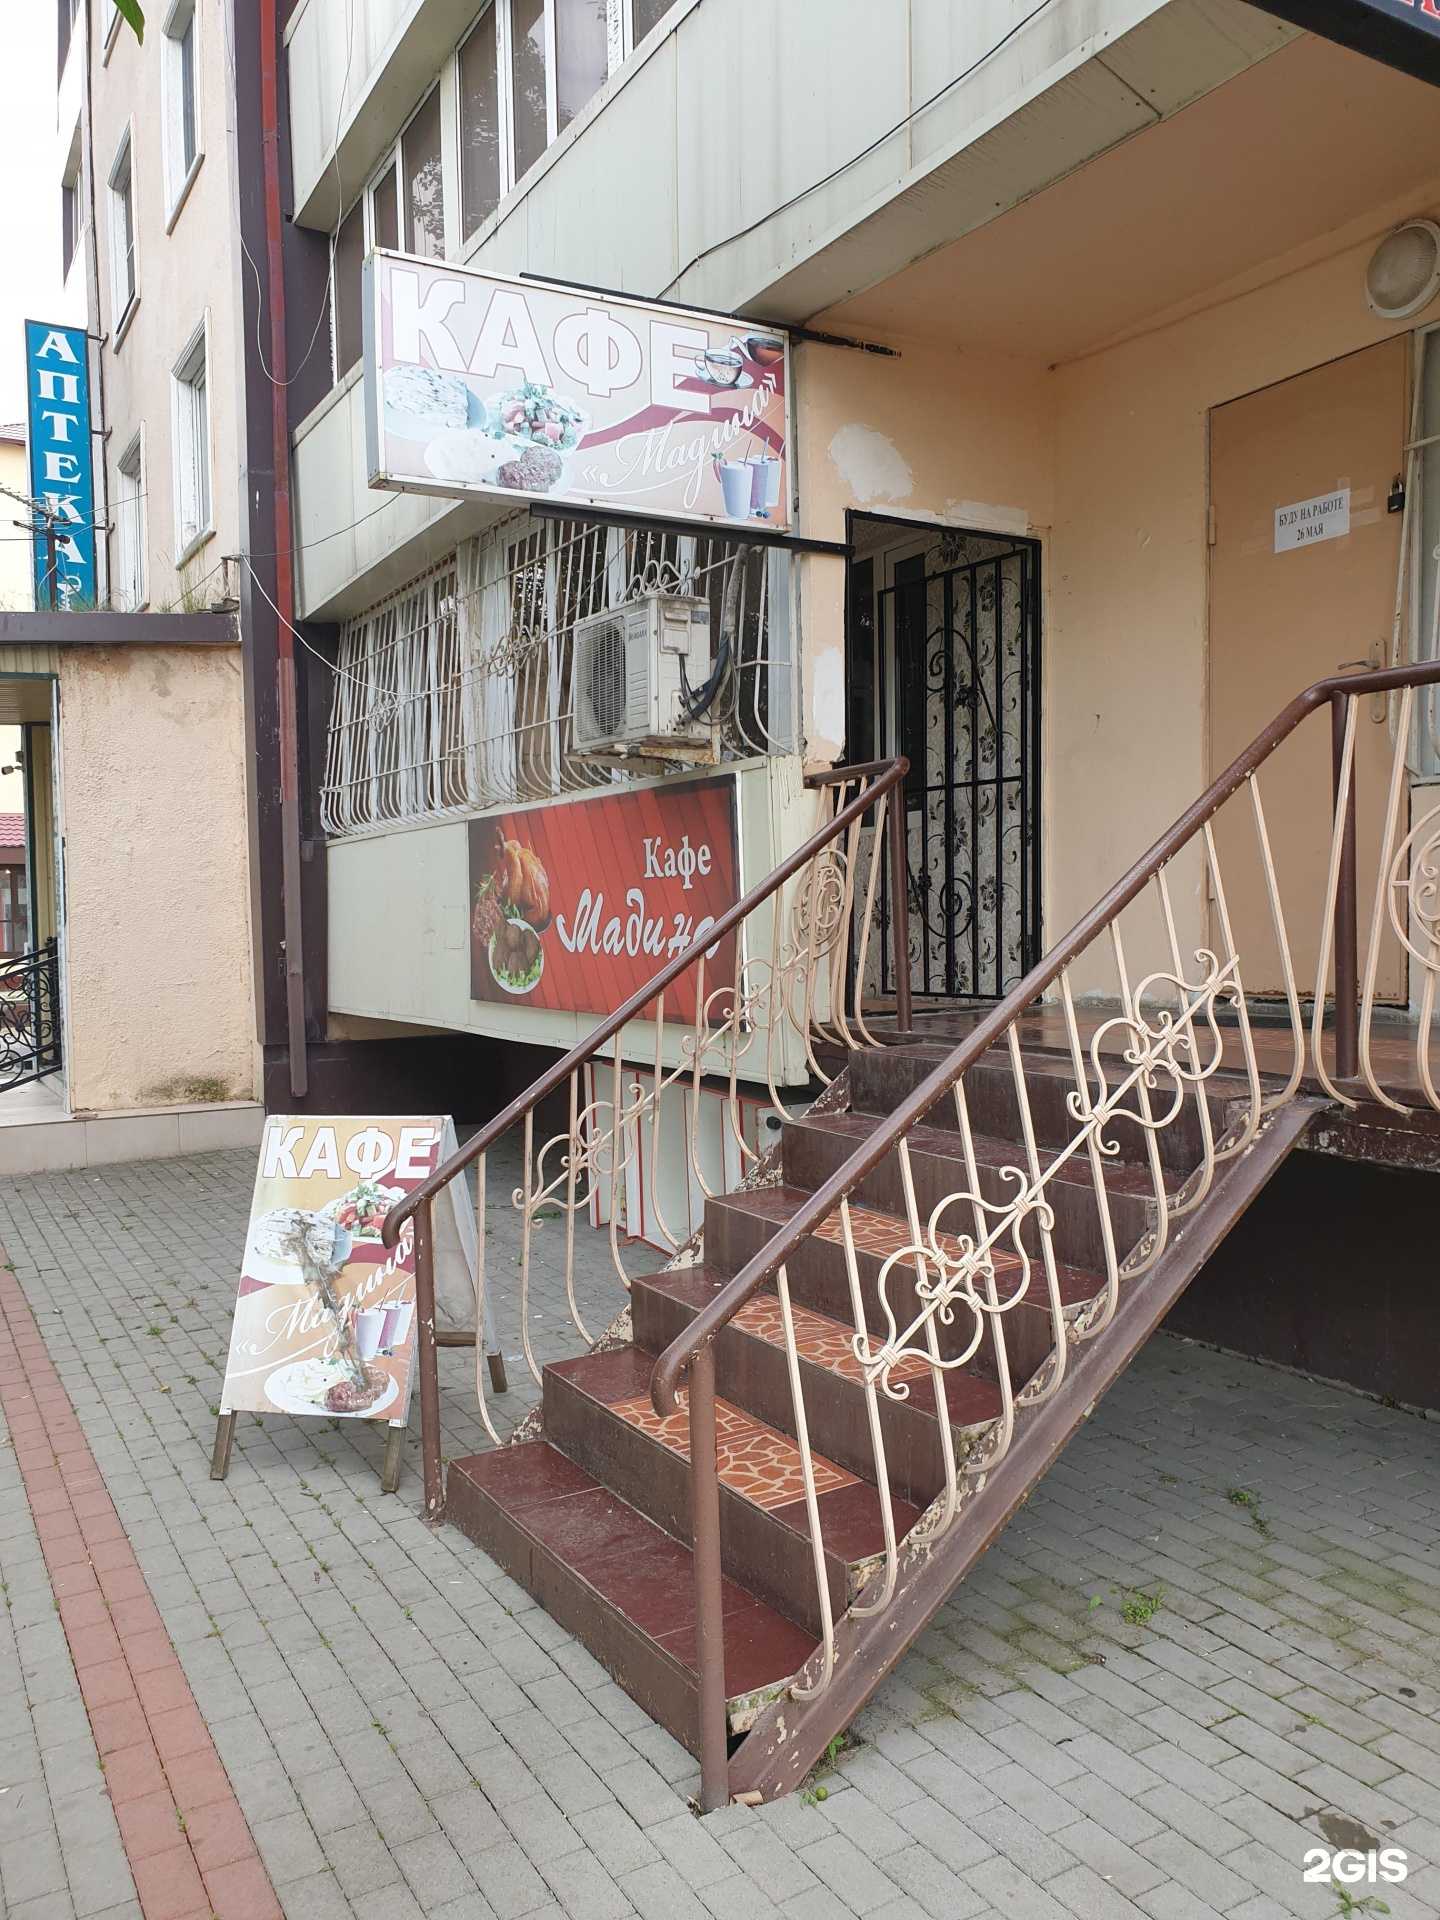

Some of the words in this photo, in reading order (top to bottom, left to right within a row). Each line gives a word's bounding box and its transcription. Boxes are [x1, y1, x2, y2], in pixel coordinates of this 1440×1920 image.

[388, 267, 712, 415] КАФЕ
[35, 330, 87, 565] АПТЕКА
[1280, 510, 1298, 527] БУДУ
[1301, 507, 1311, 520] НА
[1313, 497, 1343, 516] РАБОТЕ
[1297, 528, 1305, 541] 26
[1306, 523, 1323, 537] МАЯ
[643, 835, 712, 890] Кафе
[262, 1125, 437, 1180] КАФЕ
